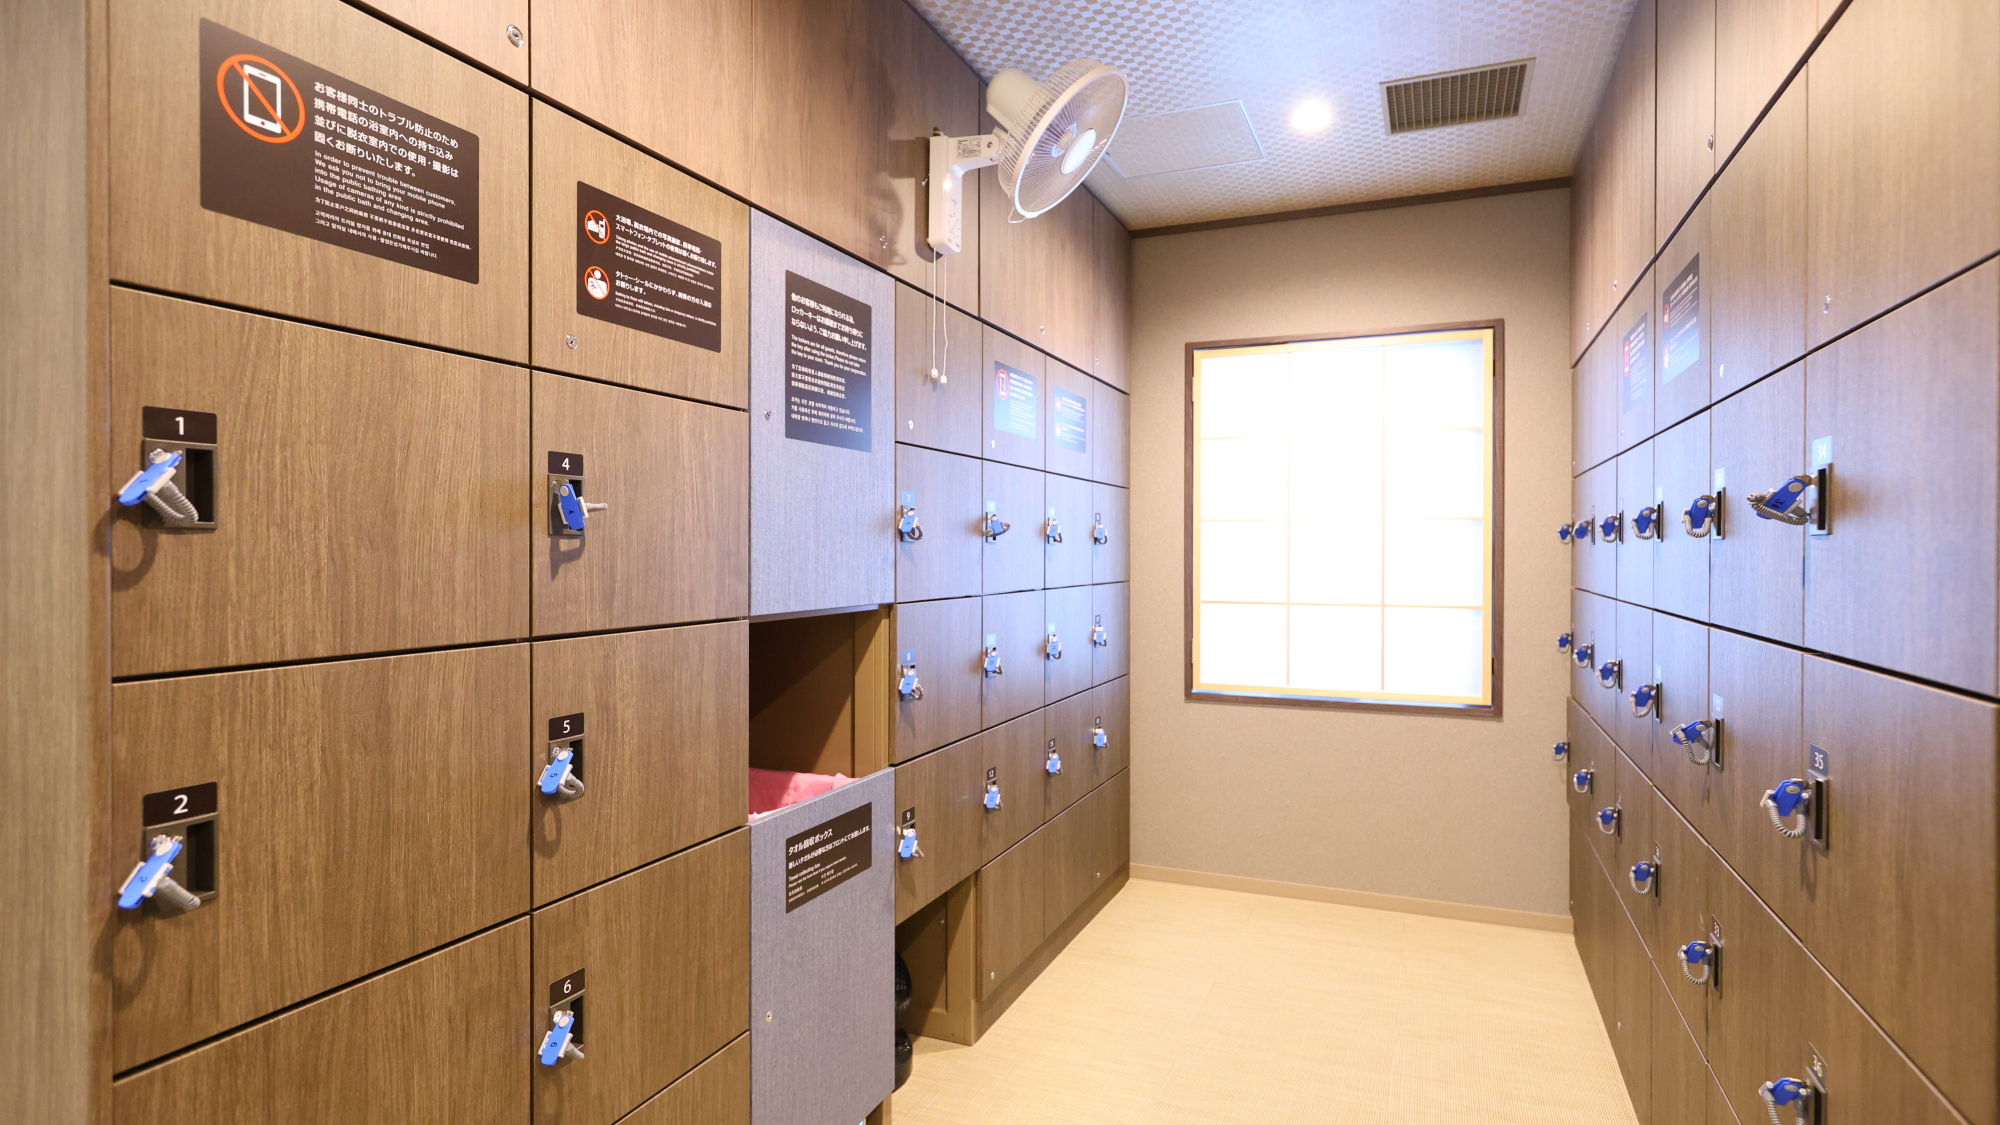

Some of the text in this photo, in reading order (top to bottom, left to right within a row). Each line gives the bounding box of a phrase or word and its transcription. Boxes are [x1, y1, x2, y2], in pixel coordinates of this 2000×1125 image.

[315, 82, 458, 148] お客様同士のトラブル防止のため
[315, 98, 453, 160] 携帯電話の浴室内への持ち込み
[314, 131, 415, 176] 固くお断りいたします。
[314, 150, 322, 161] In
[323, 154, 342, 166] order
[351, 164, 376, 177] prevent
[377, 173, 398, 185] trouble
[400, 181, 425, 194] between
[426, 191, 456, 206] customers,
[314, 158, 326, 168] We
[328, 164, 340, 172] ask
[342, 169, 354, 177] you
[375, 180, 391, 191] bring
[407, 192, 426, 202] mobile
[428, 199, 445, 209] phone
[314, 167, 403, 202] into the public bathing area.
[315, 175, 337, 188] Usage
[347, 187, 374, 200] cameras
[384, 196, 395, 208] any
[396, 202, 409, 212] kind
[417, 210, 436, 221] strictly
[437, 217, 464, 230] prohibited
[323, 186, 334, 195] the
[336, 192, 356, 202] public
[357, 197, 372, 207] bath
[386, 208, 414, 222] changing
[415, 218, 429, 226] area.
[175, 416, 184, 435] 1
[1818, 444, 1826, 460] 34
[562, 458, 570, 470] 4
[906, 494, 911, 503] 7
[1770, 498, 1784, 509] 34
[906, 652, 911, 661] 8
[563, 720, 570, 734] 5
[1814, 752, 1824, 770] 35
[173, 794, 188, 814] 2
[906, 812, 911, 820] 9
[564, 980, 572, 994] 6
